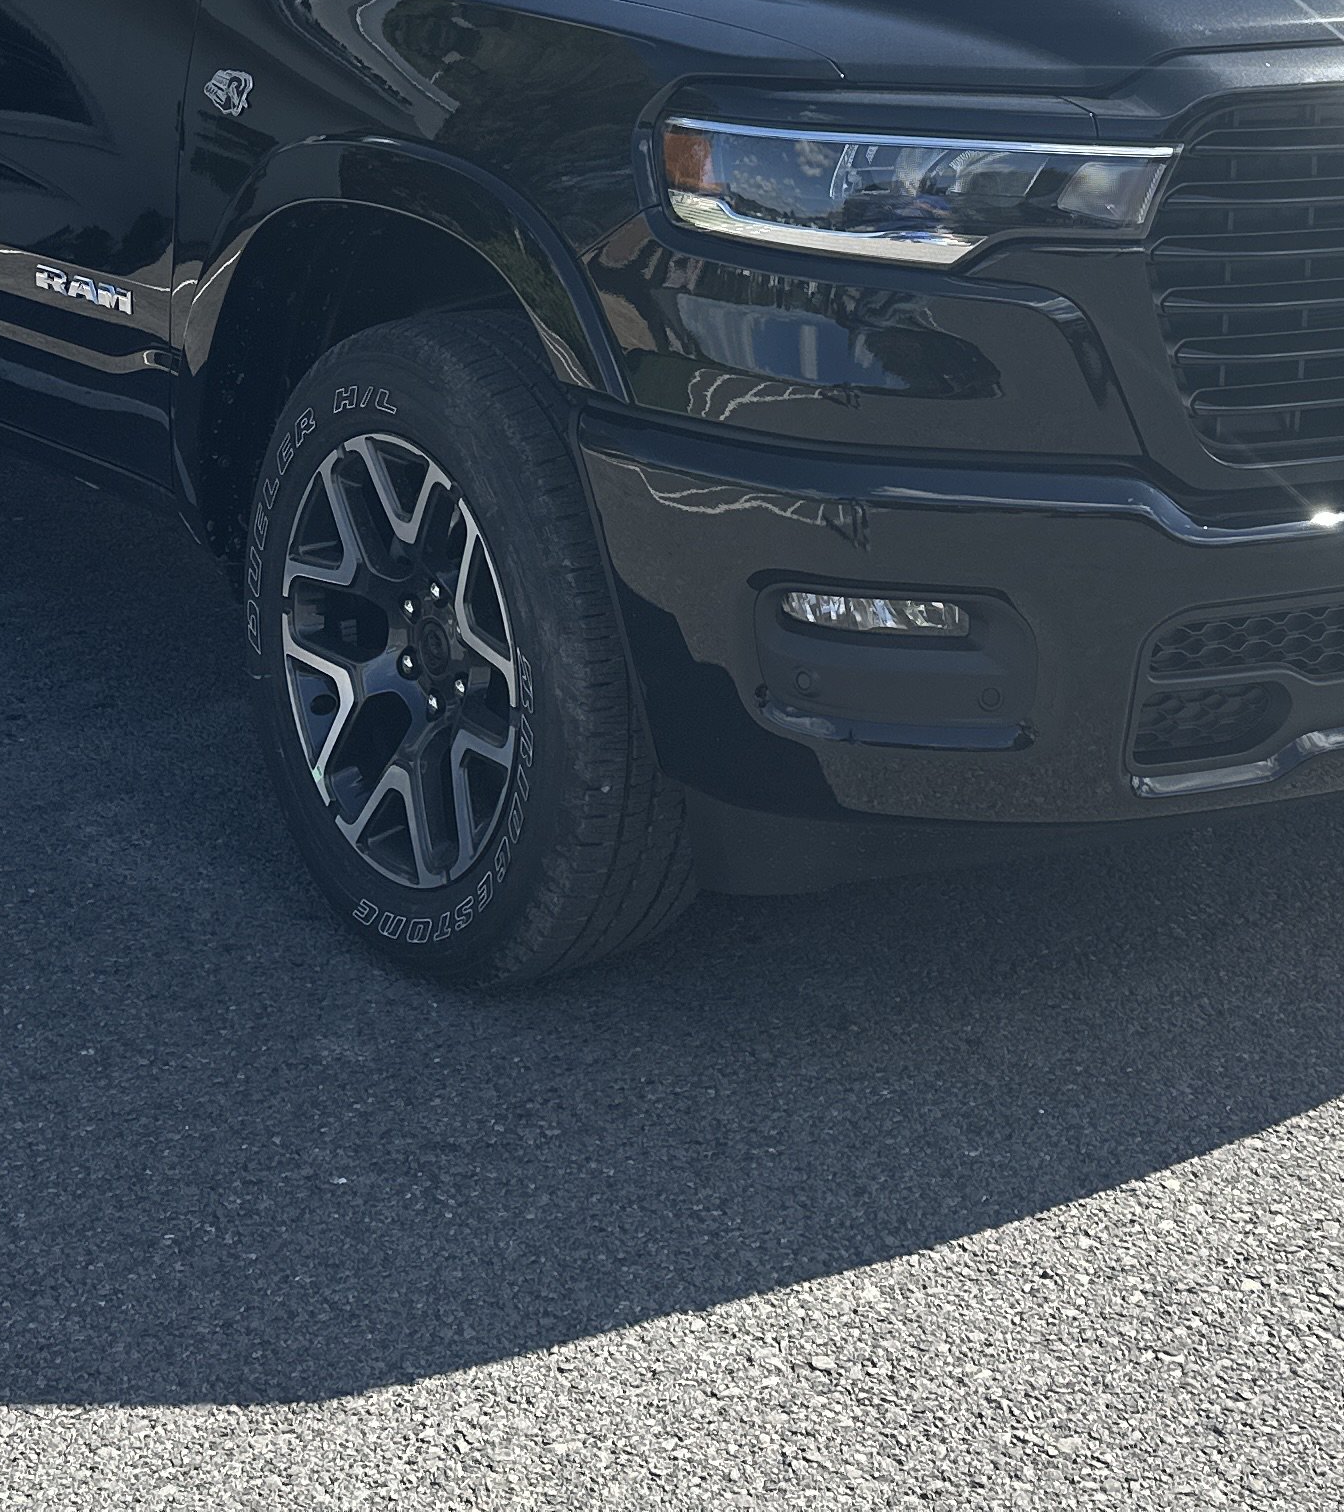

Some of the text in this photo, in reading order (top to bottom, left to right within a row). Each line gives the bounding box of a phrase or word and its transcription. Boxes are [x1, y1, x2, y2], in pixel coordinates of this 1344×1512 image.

[35, 264, 134, 315] RAM
[247, 385, 397, 655] DUELER H/L
[352, 647, 534, 944] BRIDGESTONE
